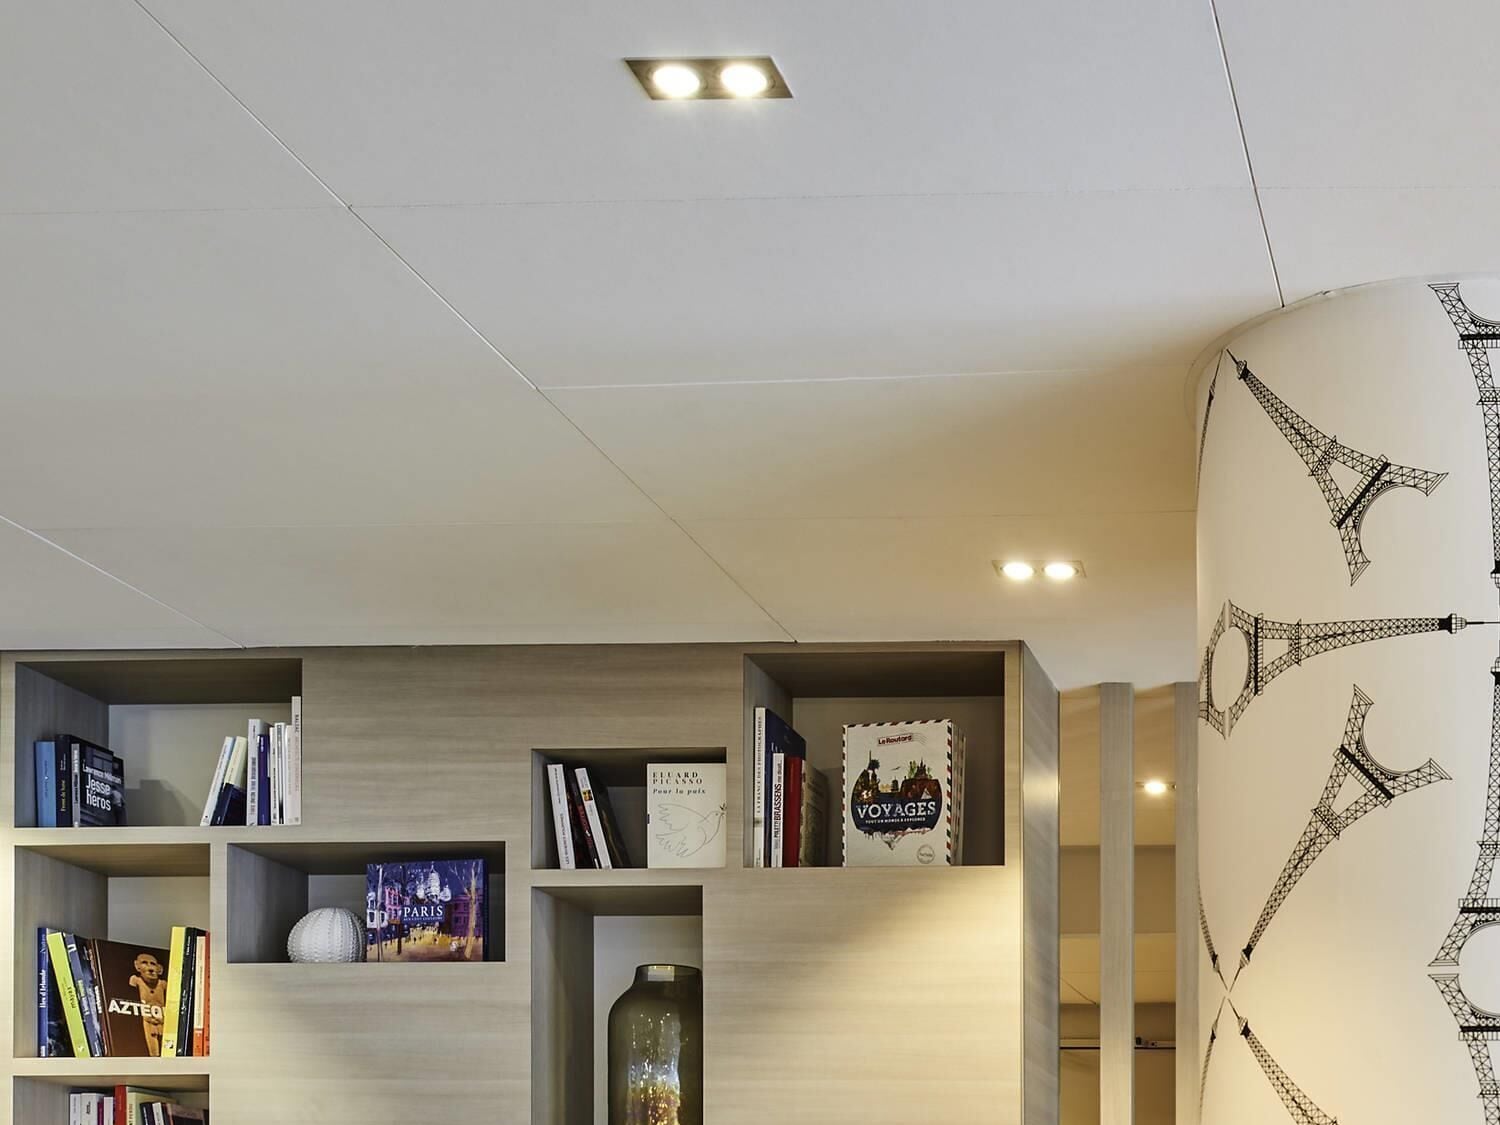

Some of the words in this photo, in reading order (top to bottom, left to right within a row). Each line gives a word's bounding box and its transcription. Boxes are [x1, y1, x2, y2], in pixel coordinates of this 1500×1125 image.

[886, 735, 913, 744] Routard
[86, 774, 111, 795] Jesse
[857, 801, 936, 819] VOYAGES
[404, 906, 443, 917] PARIS
[108, 998, 165, 1019] AZTÈQ
